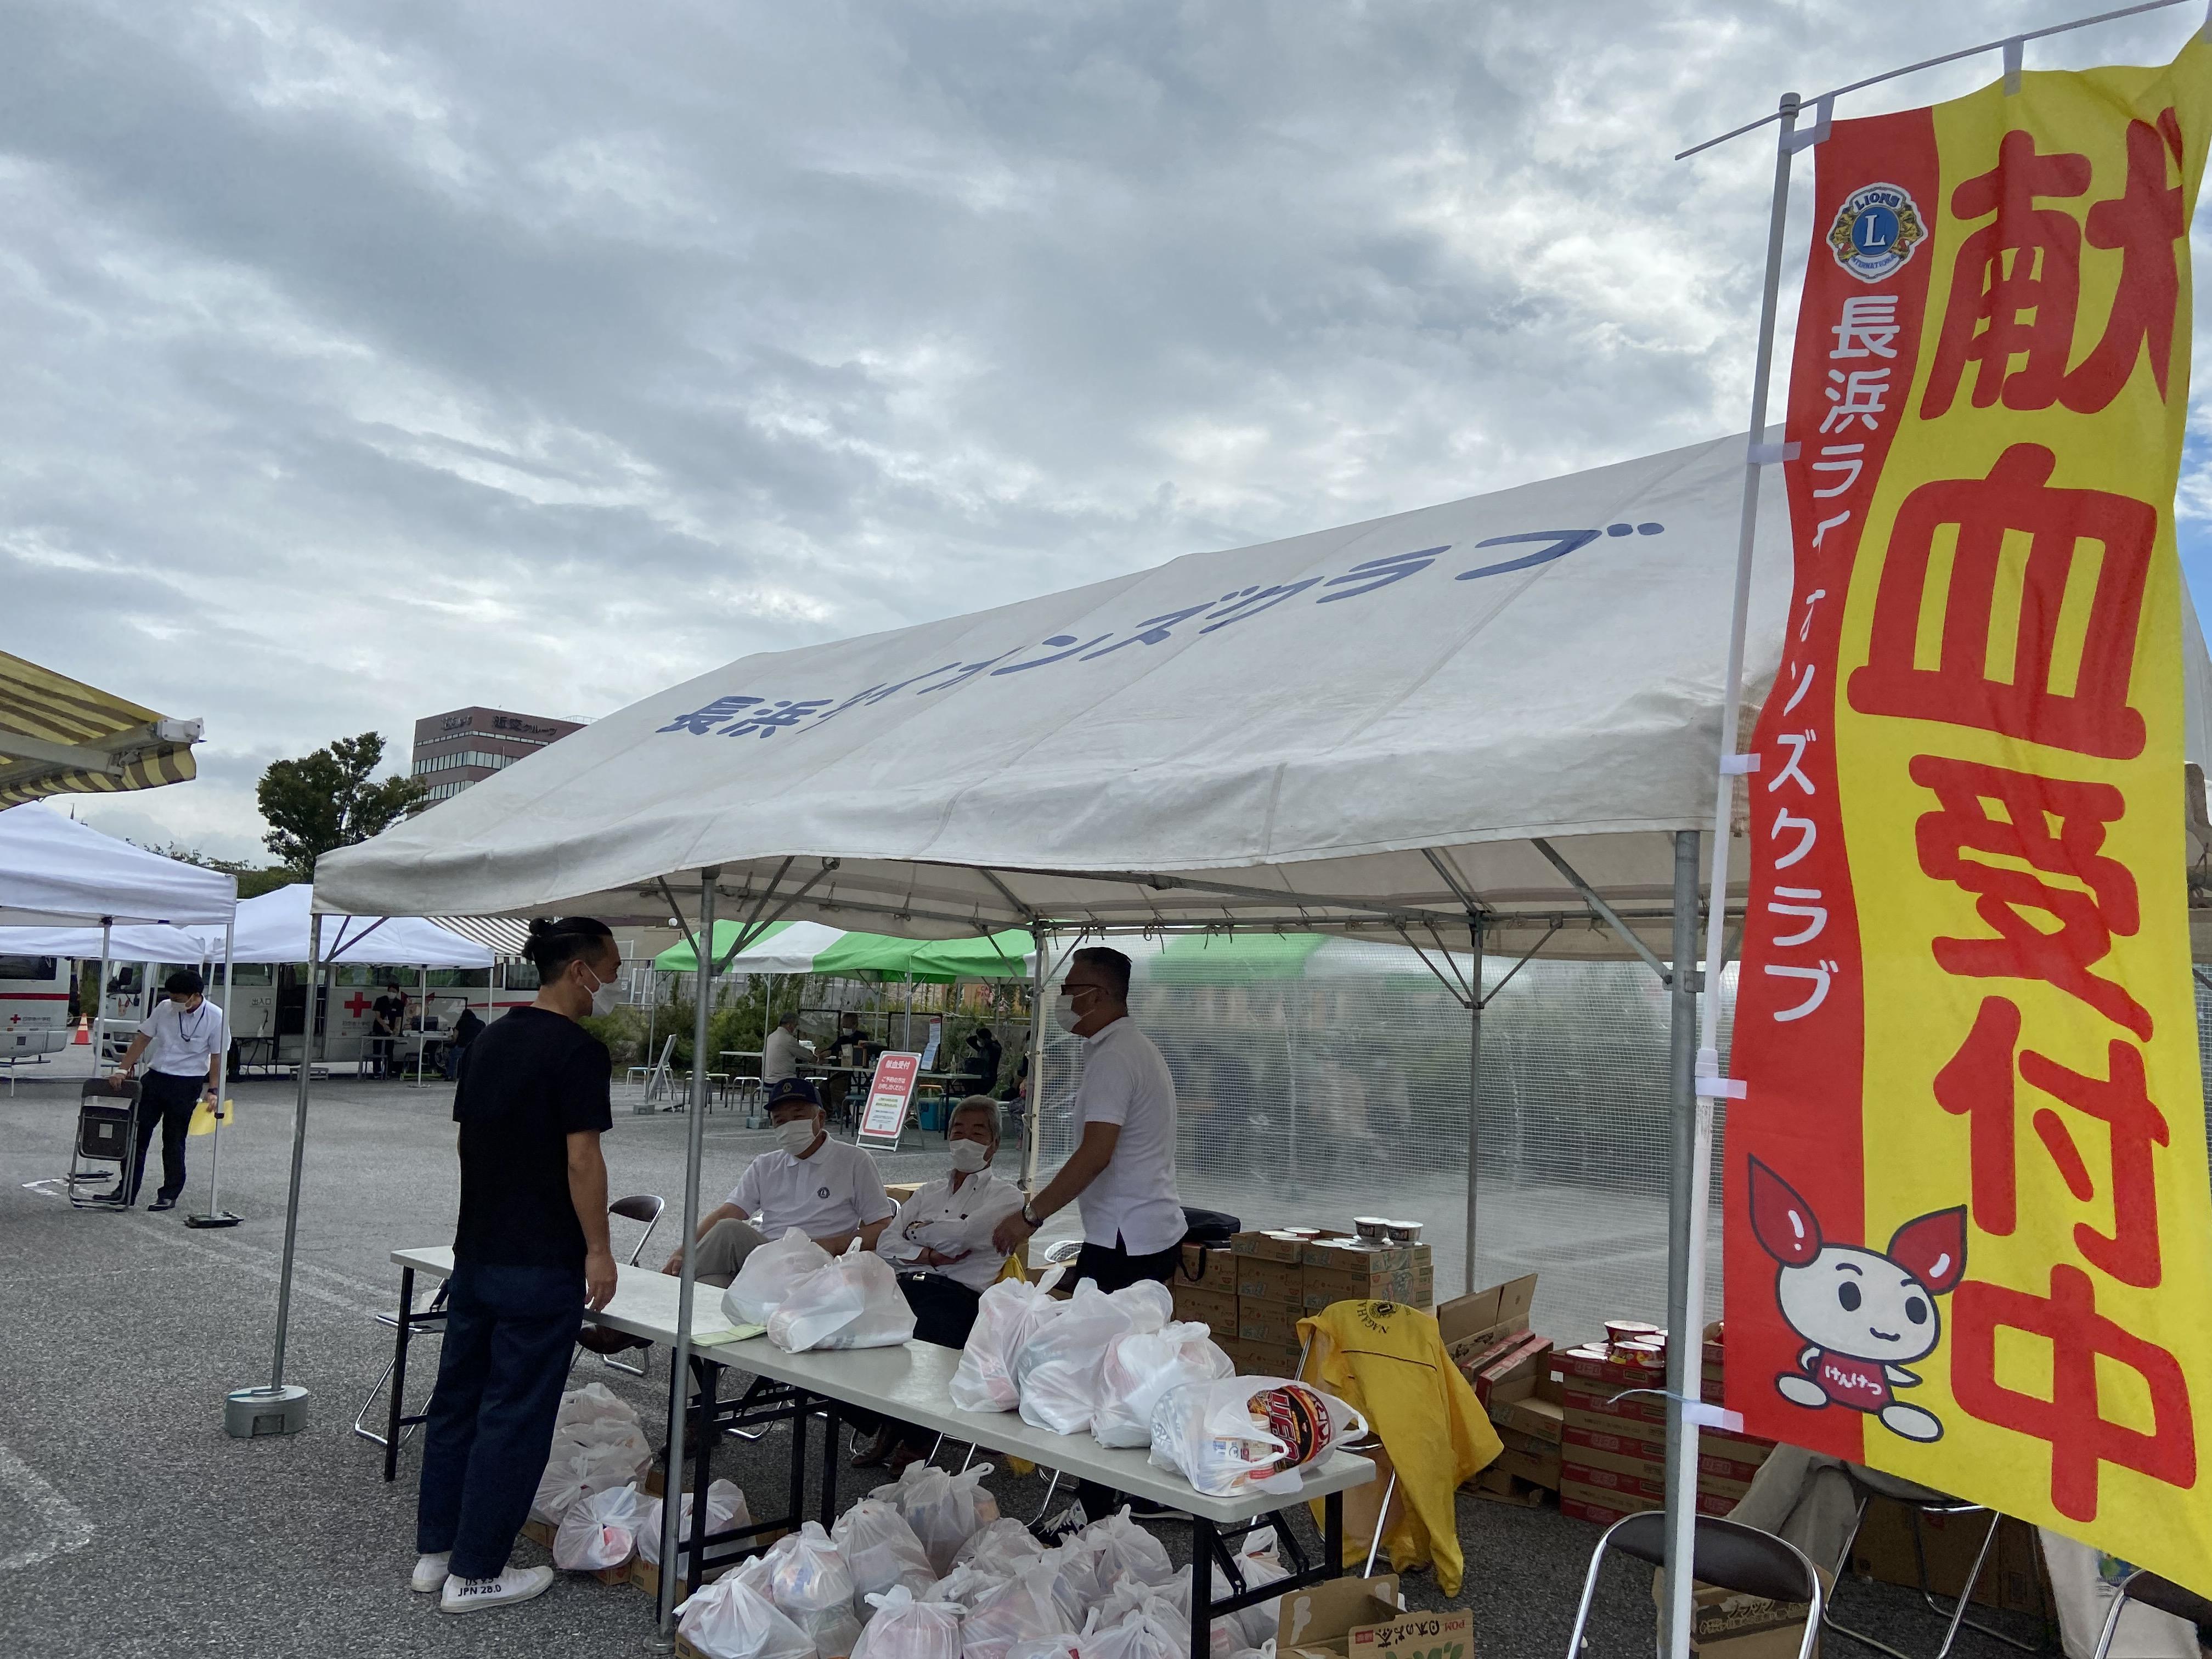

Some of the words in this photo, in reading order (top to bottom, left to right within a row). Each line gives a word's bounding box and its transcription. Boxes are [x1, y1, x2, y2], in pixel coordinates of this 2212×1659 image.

[1854, 192, 1900, 211] LIONS
[1863, 214, 1886, 247] L
[1847, 107, 2196, 1522] 献血受付中
[885, 1060, 911, 1070] 献血受付
[1825, 1365, 1882, 1395] けんけつ
[458, 1586, 477, 1597] JPN
[481, 1584, 501, 1594] 28.0
[1375, 1620, 1440, 1648] 日本のお茶
[1444, 1620, 1466, 1632] POM
